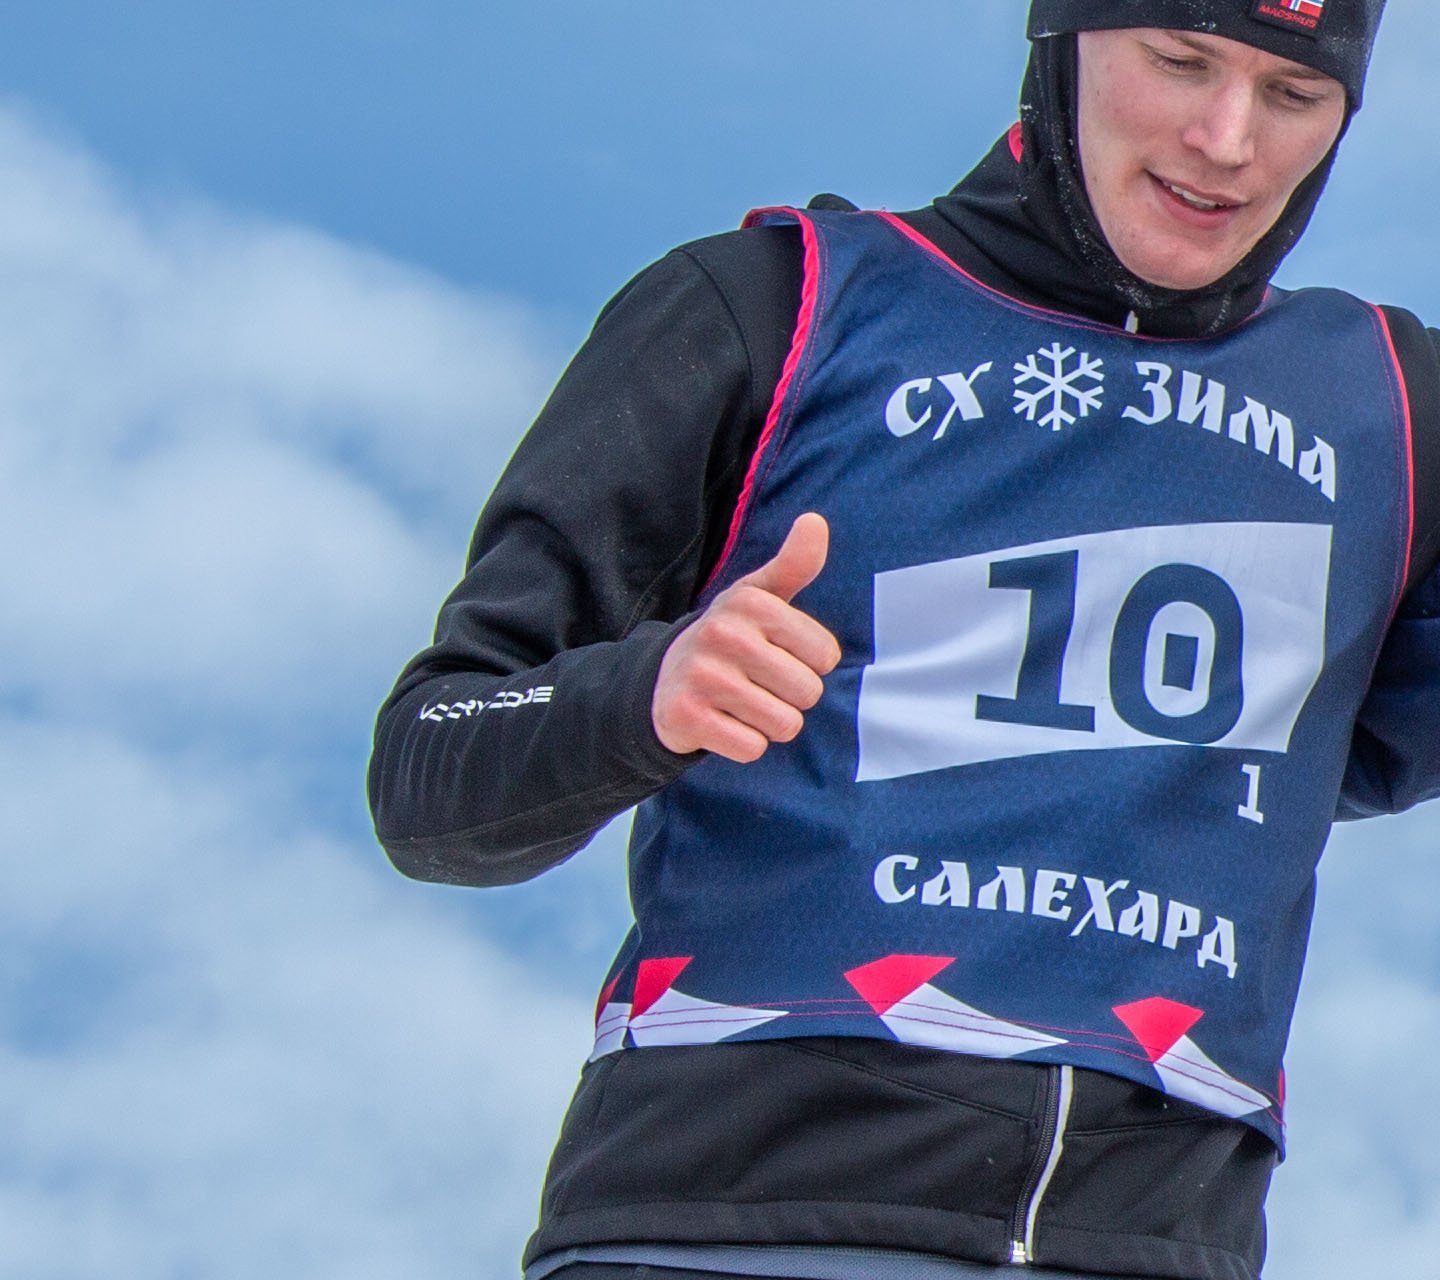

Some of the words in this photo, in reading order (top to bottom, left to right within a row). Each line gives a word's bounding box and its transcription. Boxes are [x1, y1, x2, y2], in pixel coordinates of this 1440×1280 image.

[884, 360, 994, 441] СХ
[1121, 360, 1337, 503] ЗИМА
[974, 549, 1244, 746] 10
[1237, 763, 1264, 825] 1
[873, 853, 1239, 979] САЛЕХАРД
